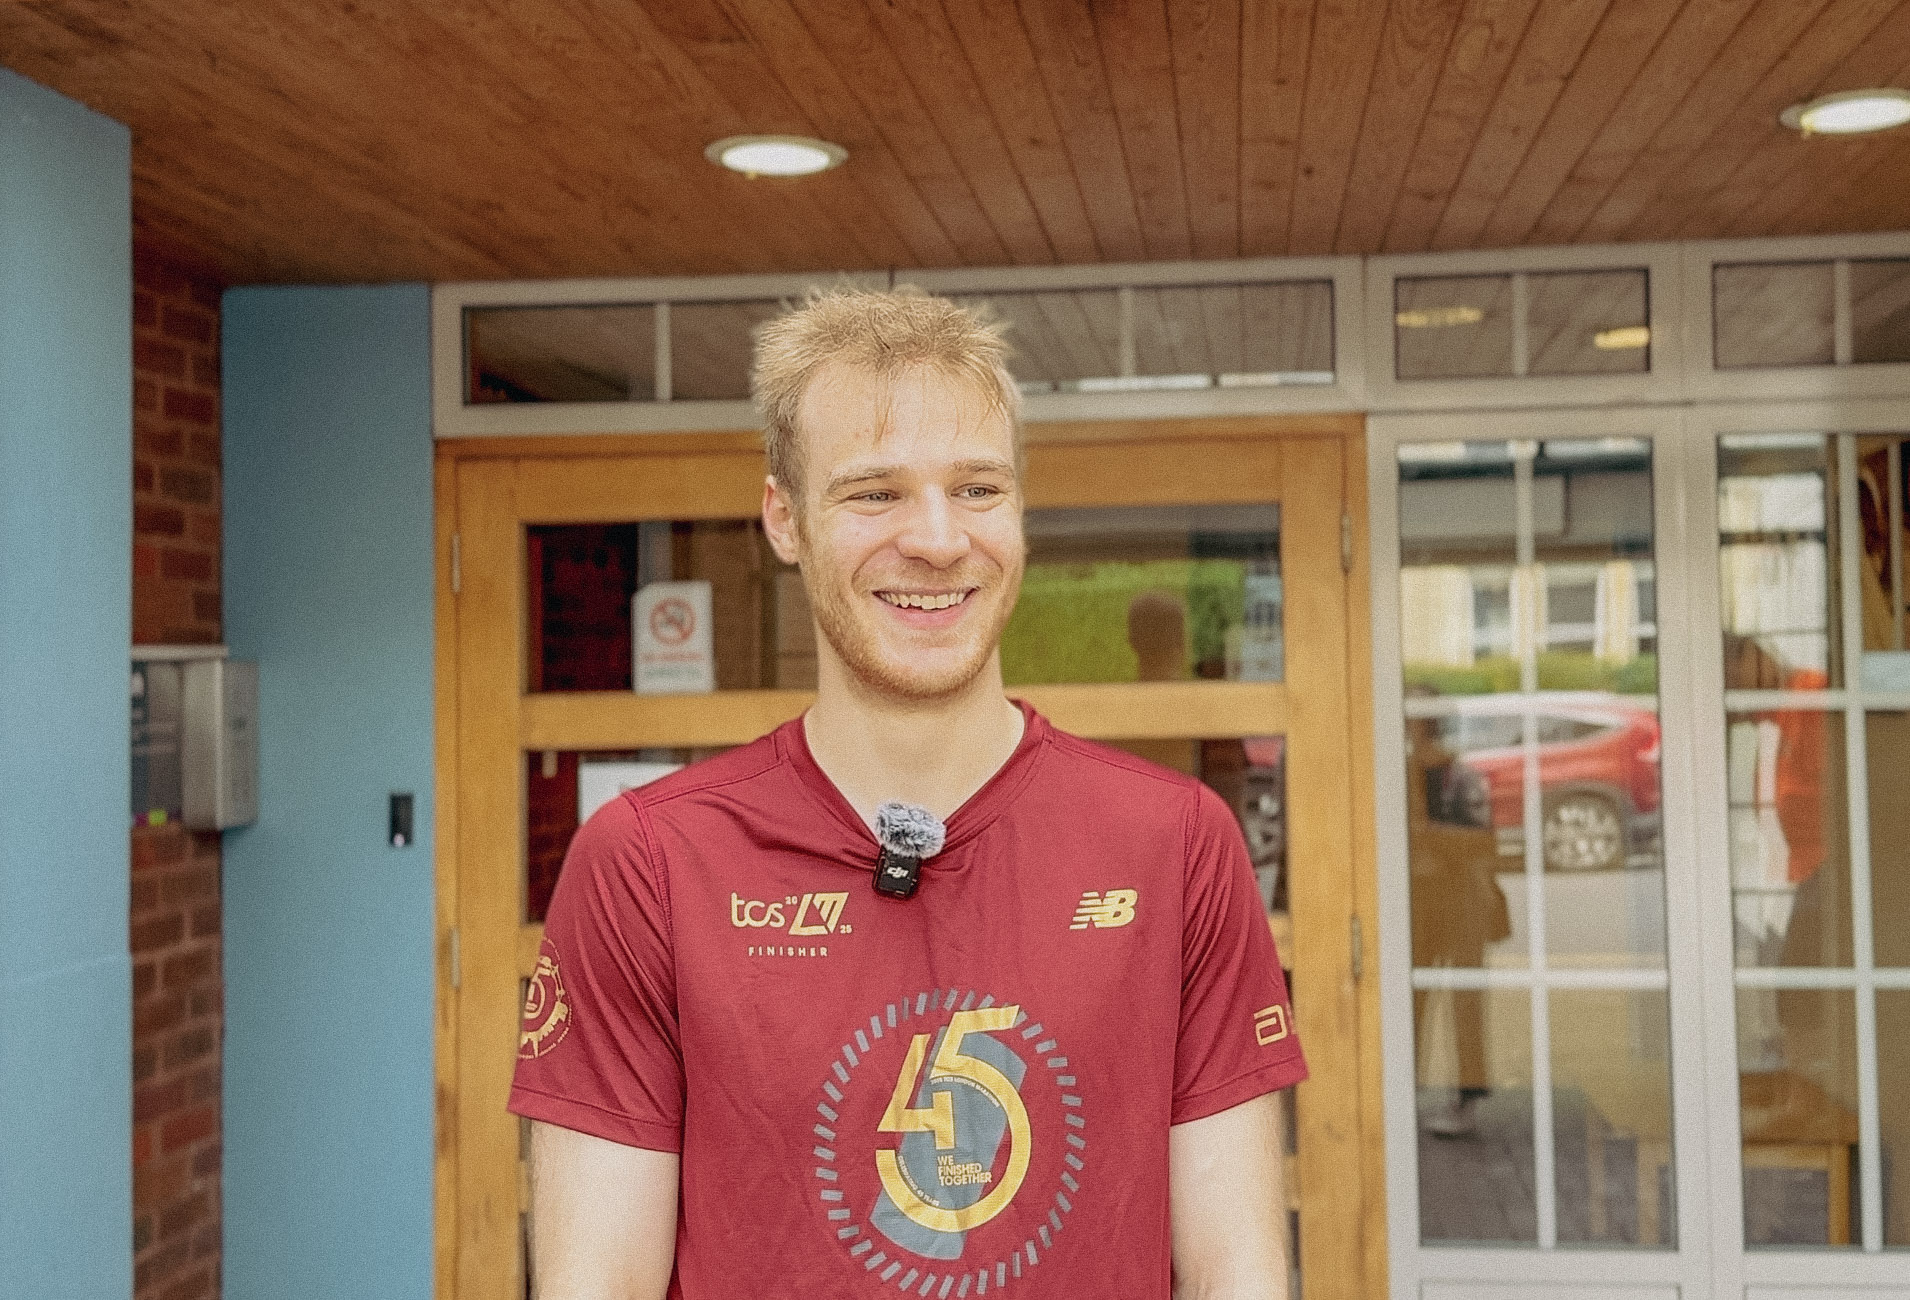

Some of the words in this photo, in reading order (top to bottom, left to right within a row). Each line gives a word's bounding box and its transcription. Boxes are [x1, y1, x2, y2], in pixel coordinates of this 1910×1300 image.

[731, 892, 786, 928] tcs
[748, 946, 828, 957] FINISHER
[875, 1004, 1032, 1233] 45
[937, 1155, 954, 1166] WE
[937, 1162, 983, 1176] FINISHED
[938, 1171, 992, 1187] TOGETHER
